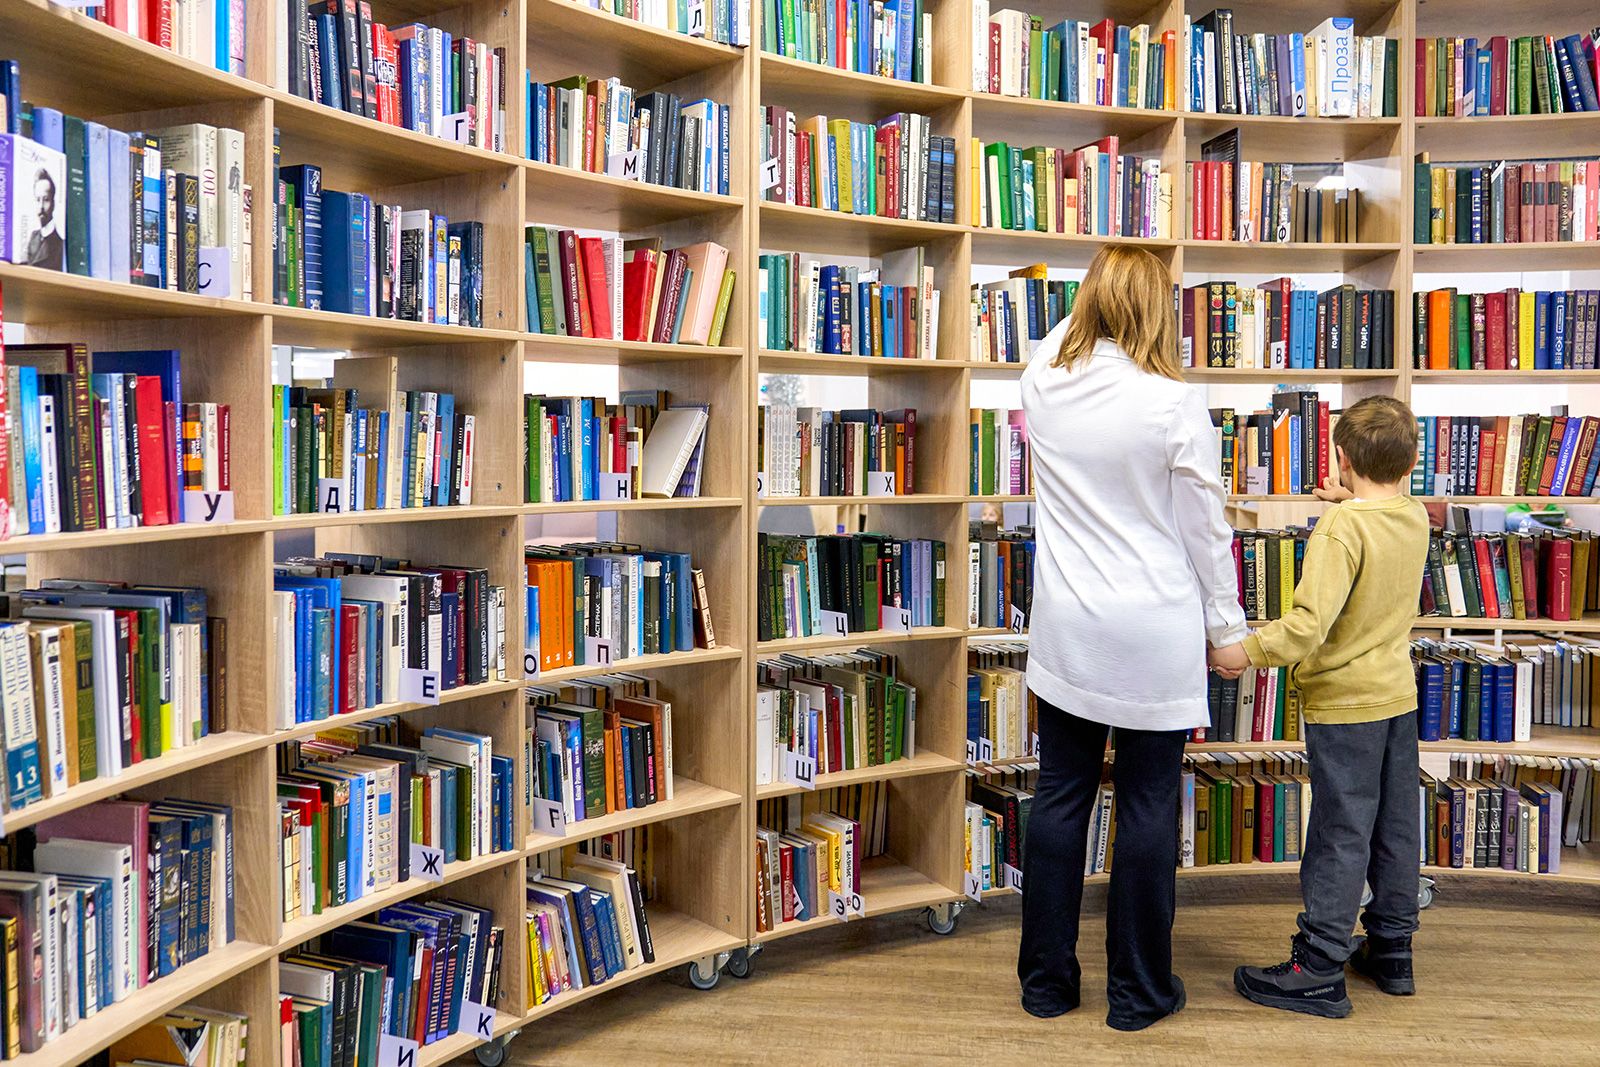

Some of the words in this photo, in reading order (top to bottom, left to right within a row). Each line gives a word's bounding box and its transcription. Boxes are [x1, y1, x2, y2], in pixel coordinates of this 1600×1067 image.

[692, 9, 701, 29] Л
[313, 20, 322, 98] привередливые
[1332, 36, 1352, 92] Проза
[456, 120, 464, 140] Г
[624, 156, 636, 176] М
[767, 165, 776, 183] Т
[203, 169, 215, 196] 100
[569, 263, 578, 299] МАЯКОВСКИЙ
[573, 302, 581, 331] ВЛАДИМИР
[1361, 295, 1369, 324] ИЛИАДА
[1275, 349, 1282, 364] В
[584, 419, 590, 429] М
[584, 436, 590, 446] Ю
[618, 480, 627, 498] Н
[885, 476, 892, 492] Х
[204, 494, 221, 521] У
[325, 487, 340, 512] Д
[836, 617, 846, 636] Ц
[902, 614, 908, 630] Ч
[3, 635, 17, 697] АНДРЕЕВ
[14, 632, 30, 693] АНДРЕЕВ
[545, 656, 550, 664] 1
[567, 651, 572, 659] 3
[598, 644, 609, 664] П
[49, 664, 60, 709] АННЕНСКИЙ
[423, 676, 435, 698] Е
[10, 702, 21, 742] Даниил
[22, 697, 32, 737] Даниил
[982, 744, 990, 760] П
[796, 760, 812, 782] Ш
[190, 851, 198, 900] АХМАТОВА
[201, 848, 210, 897] АХМАТОВА
[422, 852, 440, 876] Ж
[337, 860, 346, 894] ЕСЕНИН
[972, 880, 978, 894] У
[190, 904, 198, 928] АННА
[201, 900, 209, 924] АННА
[836, 899, 844, 916] Э
[478, 1012, 492, 1036] К
